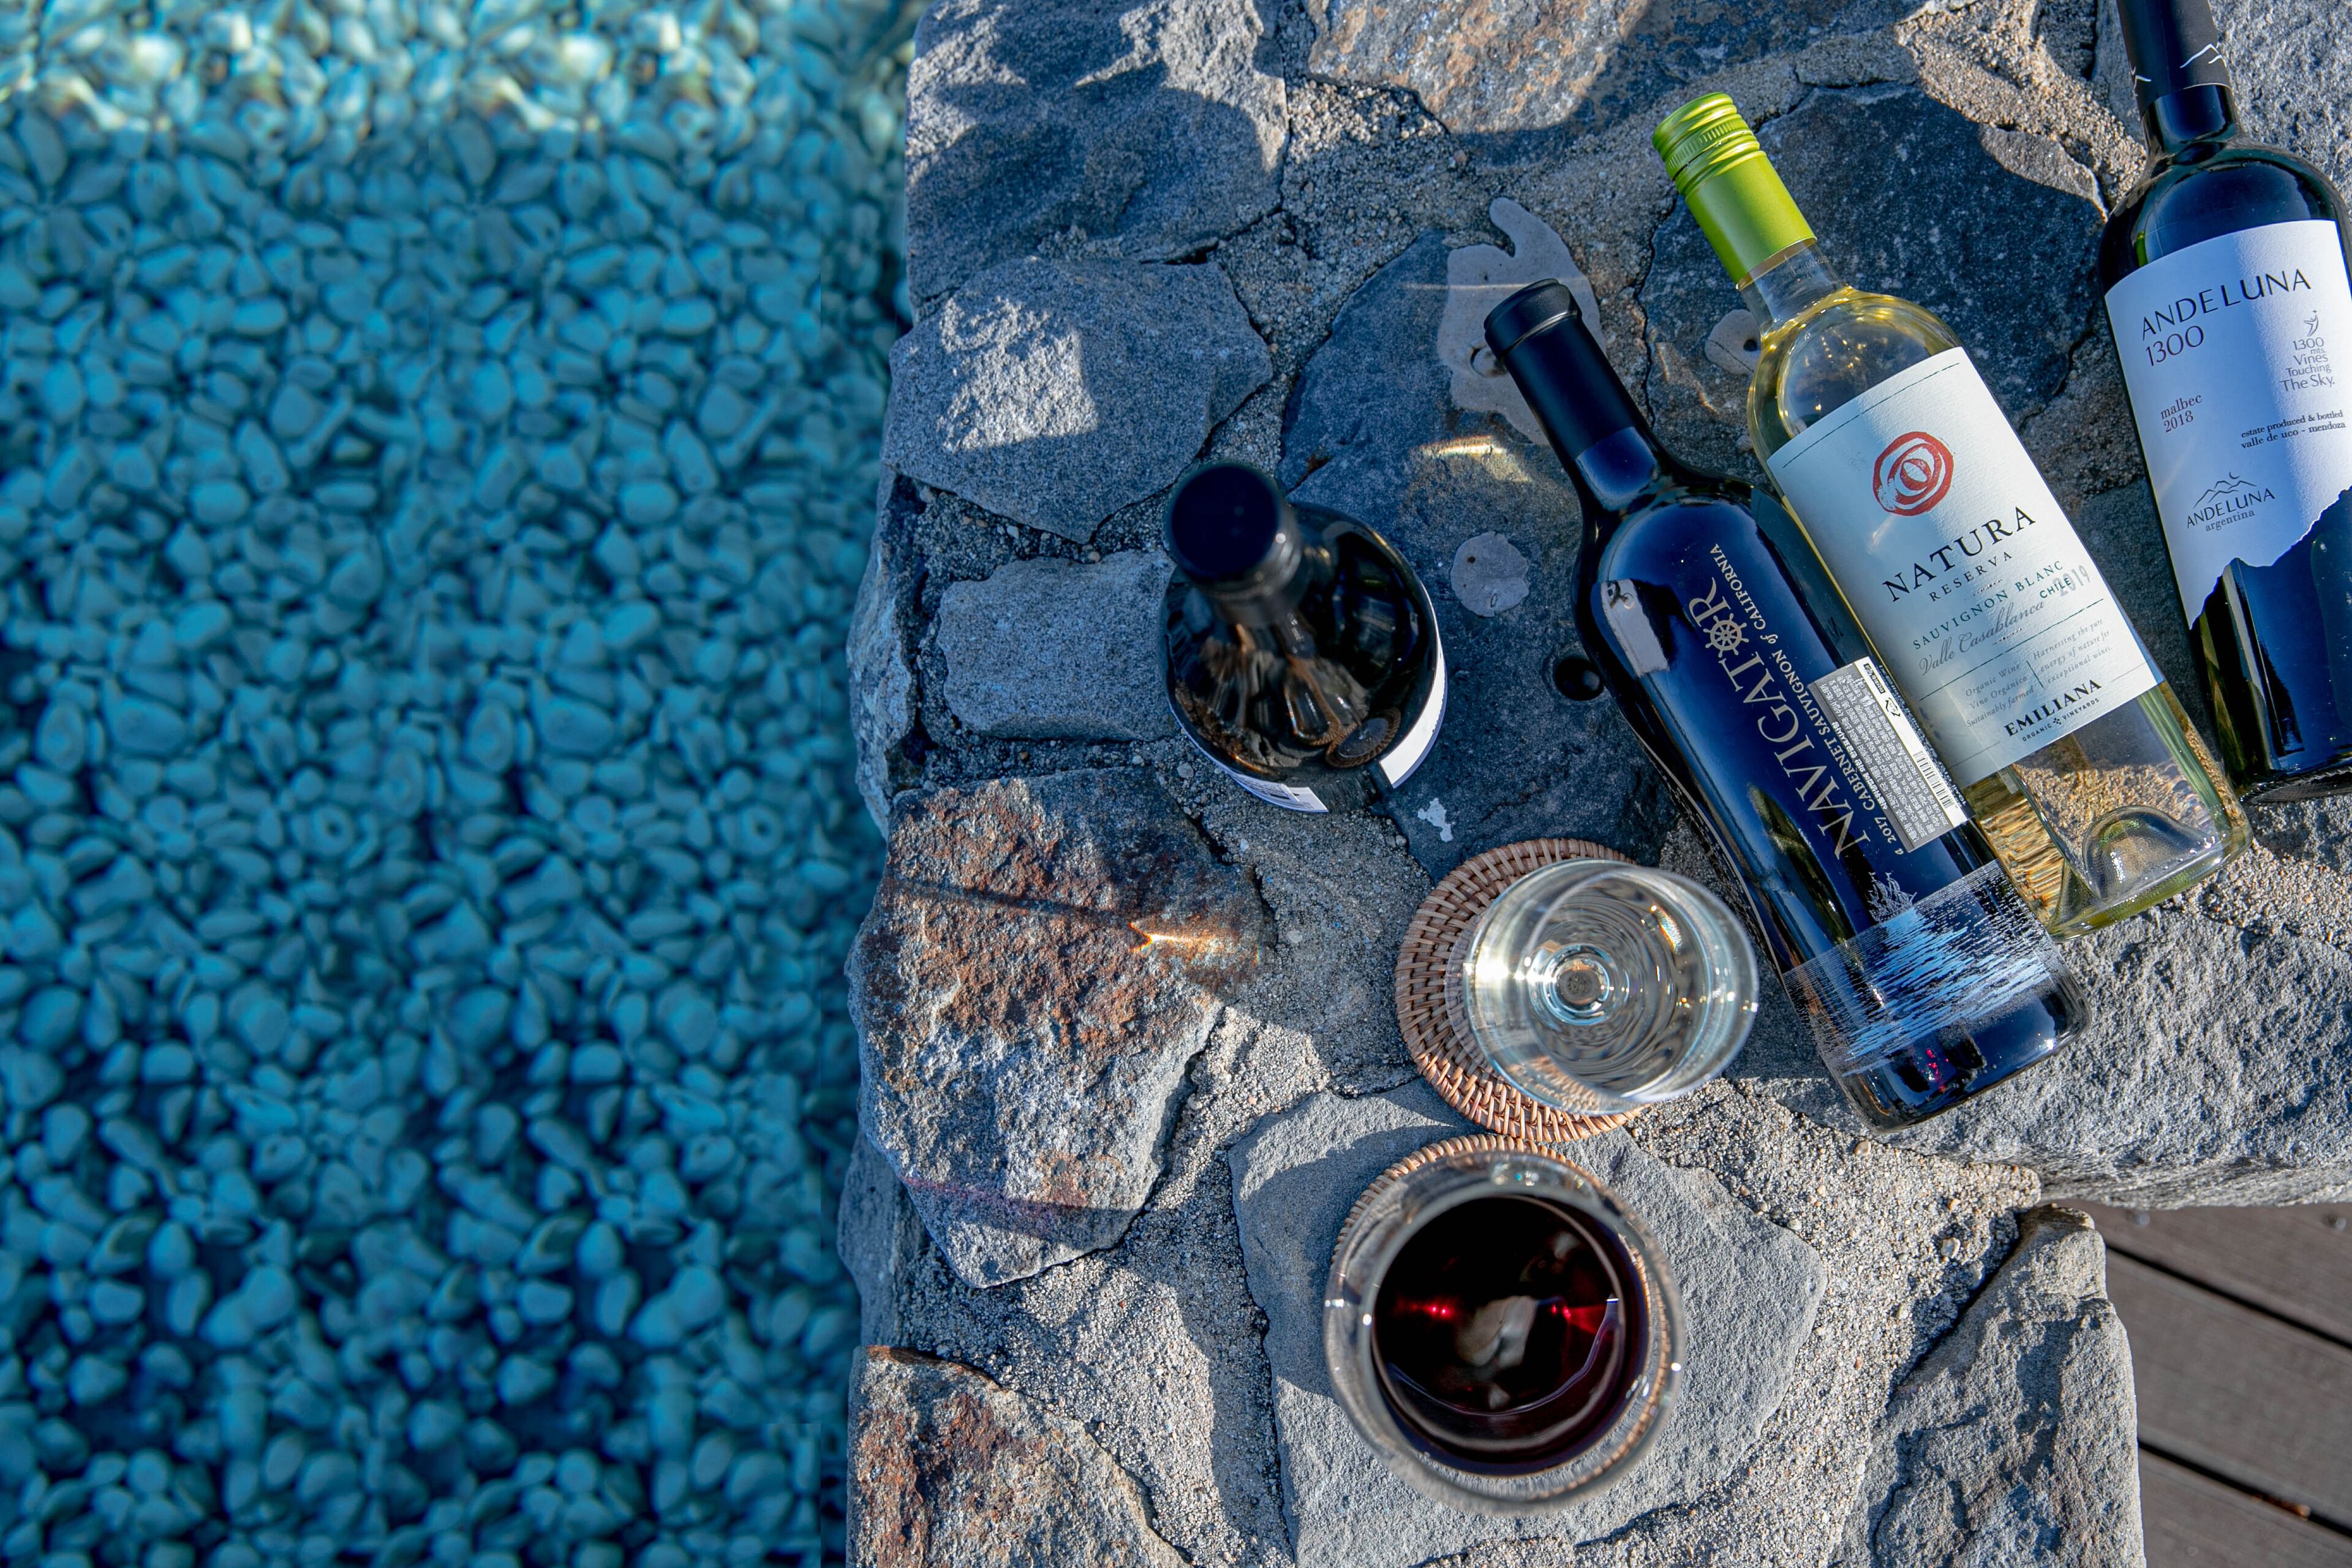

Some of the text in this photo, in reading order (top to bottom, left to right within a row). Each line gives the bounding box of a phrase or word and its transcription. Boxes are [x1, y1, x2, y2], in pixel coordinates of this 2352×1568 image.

[2143, 268, 2312, 341] ANDELUNA
[2145, 325, 2204, 366] 1300
[2293, 353, 2328, 366] Vines
[2280, 374, 2335, 393] The Sky.
[2286, 363, 2332, 377] Touching
[2160, 394, 2203, 420] malbec
[2163, 410, 2194, 433] 2018
[2241, 426, 2265, 438] estate
[2267, 416, 2305, 432] produced
[2317, 410, 2343, 421] bottled
[2241, 437, 2264, 449] valle
[2266, 432, 2278, 442] de
[2282, 429, 2299, 439] uco
[2309, 421, 2346, 433] mendoza
[2187, 488, 2275, 529] ANDELUNA
[2205, 509, 2255, 532] argentina
[1882, 506, 2036, 603] NATURA
[1709, 543, 1766, 630] CALIFORNIA
[1929, 551, 2013, 601] RESERVA
[2040, 576, 2071, 599] CHILE
[2052, 565, 2090, 598] 2019
[1913, 560, 2064, 650] SAUVIGNON BLANC
[1759, 633, 1778, 644] of
[1919, 601, 2045, 676] Valle Casablanca
[2033, 619, 2103, 660] Harnessing the pure
[2040, 630, 2110, 672] energy of nature for
[1966, 663, 2021, 697] Organic Wine
[2048, 654, 2091, 684] exceptional
[1771, 649, 1830, 735] SAUVIGNON
[1966, 685, 2035, 728] Sustainably farmed
[1969, 675, 2027, 710] Vino Orgánico
[2003, 679, 2102, 737] EMILIANA
[1831, 720, 1858, 759] 한글표시사항
[2022, 698, 2100, 742] ORGANIC VINEYARDS
[1823, 737, 1875, 810] CABERNET
[1874, 816, 1897, 843] 2017
